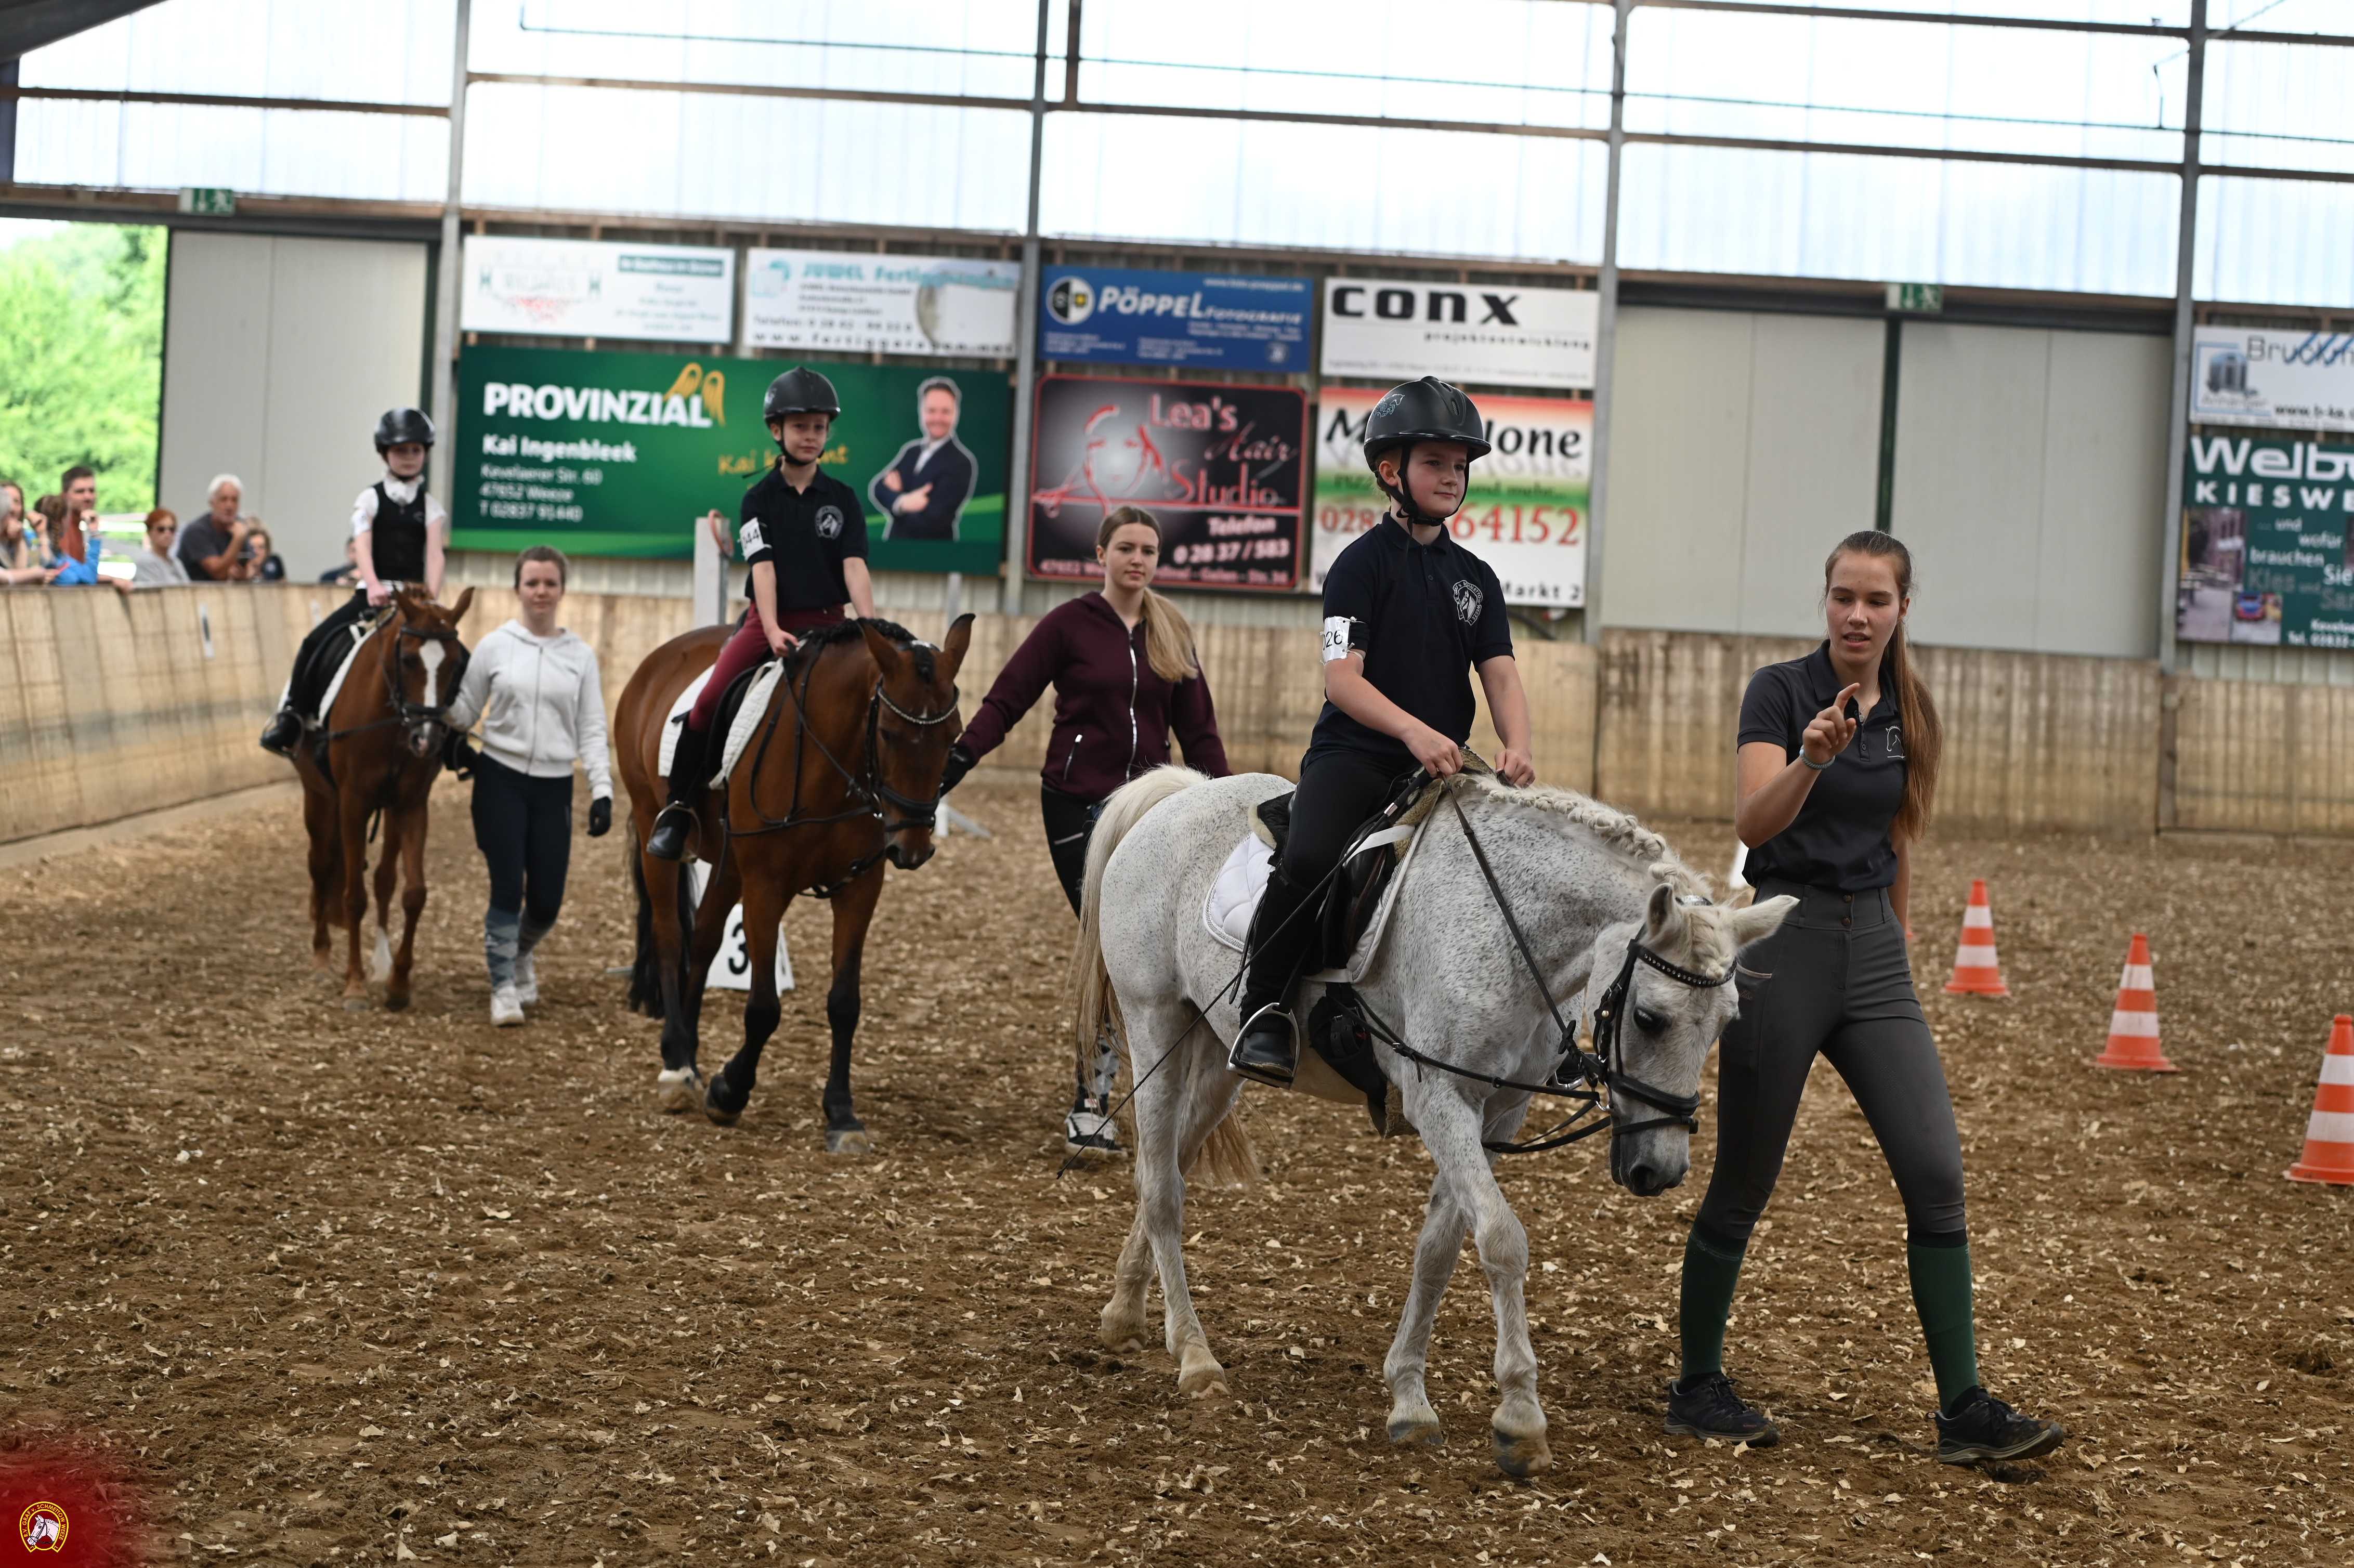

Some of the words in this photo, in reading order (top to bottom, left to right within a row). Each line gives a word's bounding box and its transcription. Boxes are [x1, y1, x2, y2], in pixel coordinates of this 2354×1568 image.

[1098, 286, 1203, 318] PÖPPEL
[483, 382, 713, 428] PROVINZIAL
[1149, 393, 1239, 431] Lea's
[482, 434, 517, 456] Kai
[521, 436, 637, 463] Ingenbleek
[717, 449, 756, 476] Kai
[1165, 459, 1286, 509] Studio
[1208, 516, 1277, 537] Telefon
[1451, 502, 1580, 547] 64152
[2274, 516, 2303, 533] und
[2250, 546, 2325, 568] brauchen
[2323, 563, 2353, 587] Sie
[1571, 583, 1581, 601] 2
[728, 922, 749, 976] 3
